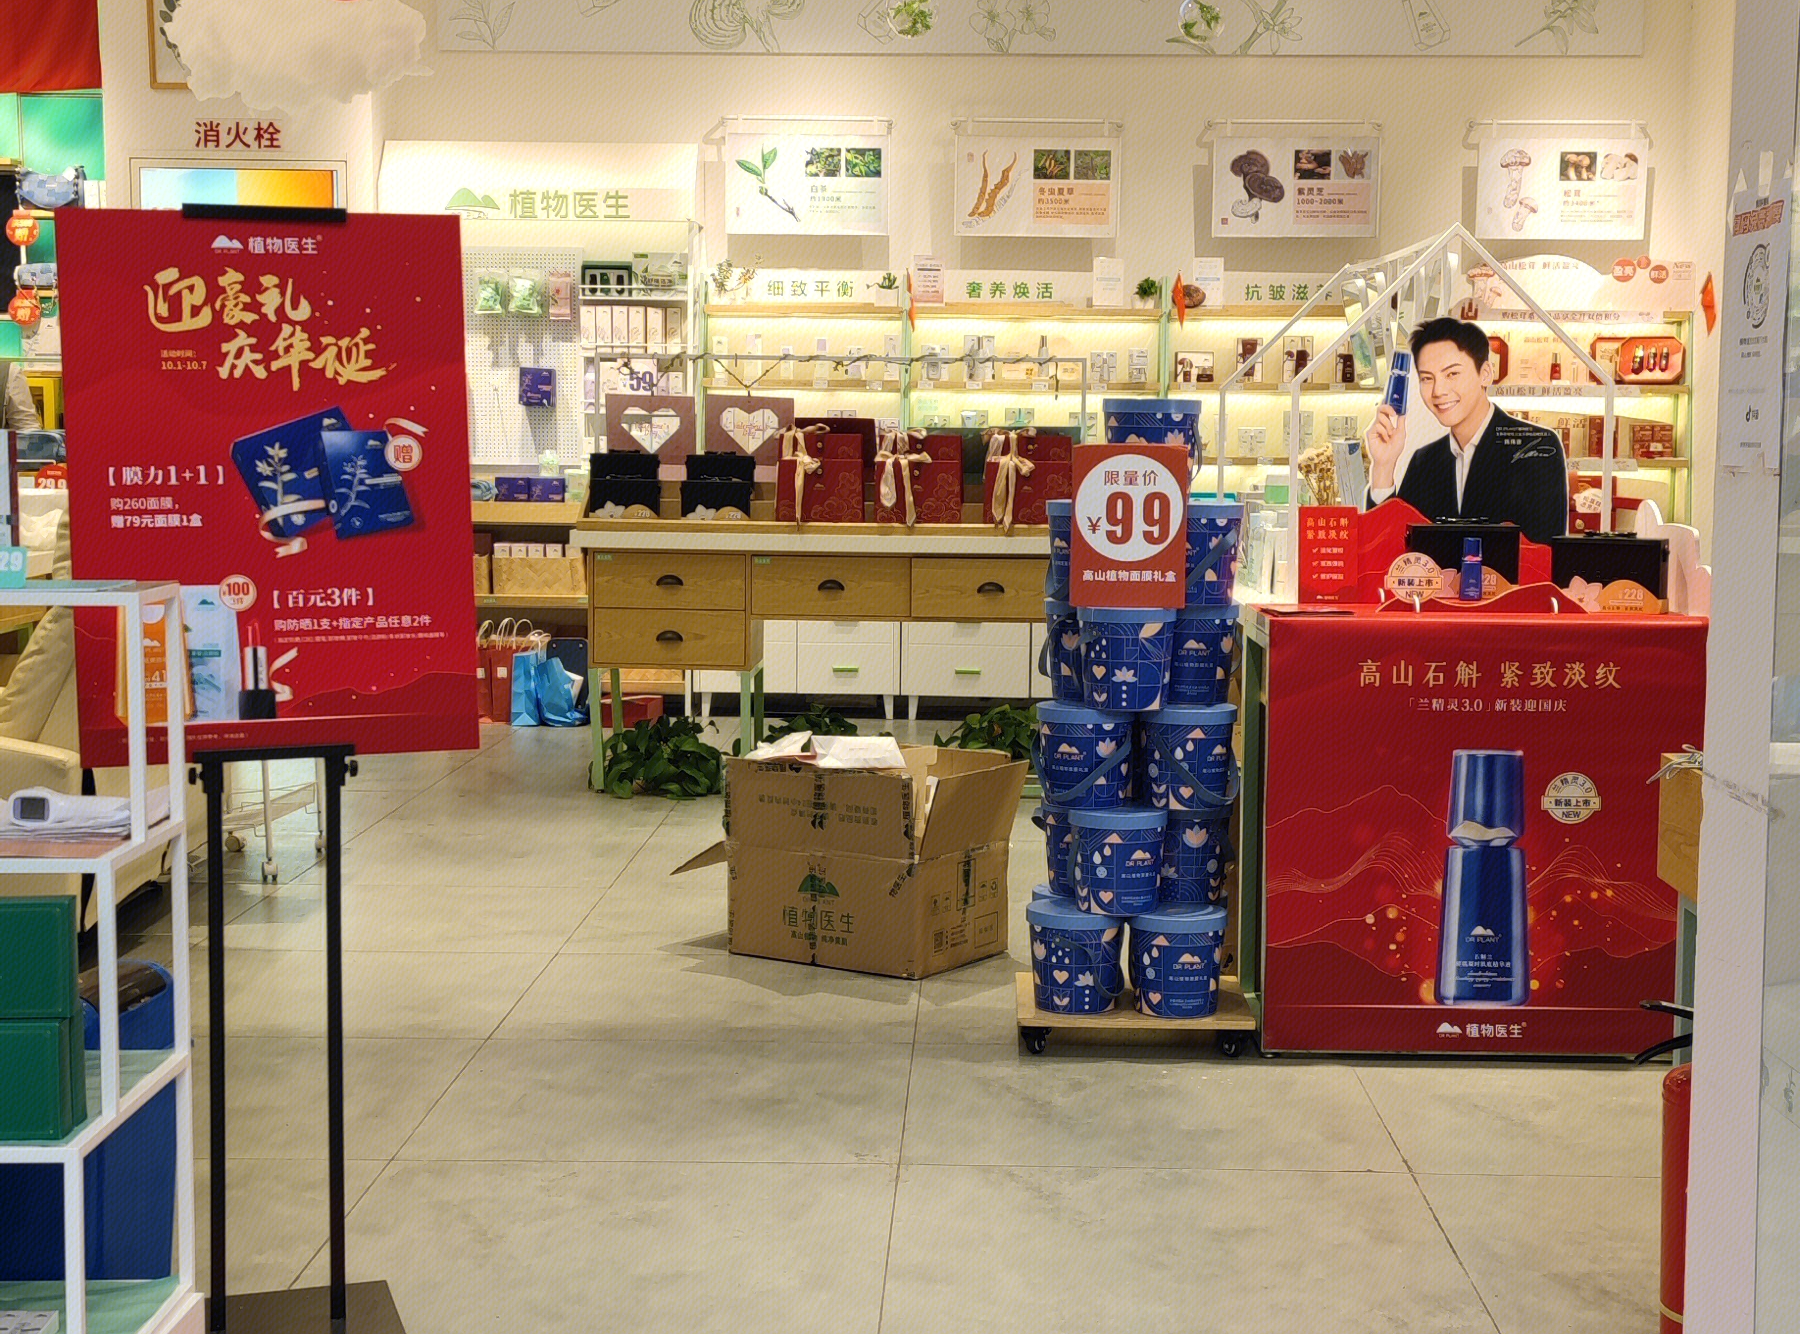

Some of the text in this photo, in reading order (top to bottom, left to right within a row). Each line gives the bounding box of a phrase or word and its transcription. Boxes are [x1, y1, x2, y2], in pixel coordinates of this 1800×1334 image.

[194, 121, 282, 150] 消火栓
[1038, 187, 1075, 196] 冬虫夏草
[1296, 187, 1325, 196] 紫灵芝
[509, 189, 631, 219] 植物医生
[248, 236, 319, 255] 植物医生
[767, 280, 855, 298] 细致平衡
[965, 281, 1055, 300] 奢养焕活
[143, 267, 312, 333] 迎豪礼
[216, 323, 394, 391] 庆华诞
[161, 361, 208, 371] 10.1-10.7
[393, 443, 414, 465] 赠
[108, 465, 225, 487] 【膜力1+1】
[1103, 469, 1159, 487] 限量价
[110, 513, 203, 529] 赠79元面膜1盒
[1306, 517, 1349, 528] 高山石斛
[1082, 569, 1177, 583] 高山植物面膜礼盒
[1397, 578, 1434, 587] 新装上市
[272, 587, 374, 609] 【百元3件】
[1177, 648, 1210, 656] DR PLANT
[1357, 659, 1623, 690] 高山石斛 紧致淡纹
[1408, 697, 1568, 713] 「兰精灵3.0」新装迎国庆
[1053, 752, 1085, 761] DR PLANT
[1552, 776, 1593, 794] 兰精灵3.0
[1554, 798, 1591, 807] 新装上市
[1561, 810, 1582, 818] NEW
[1136, 859, 1155, 867] PLANT
[783, 905, 855, 934] 植物医生
[1184, 962, 1206, 970] PLANT
[1466, 1023, 1524, 1039] 植物医生
